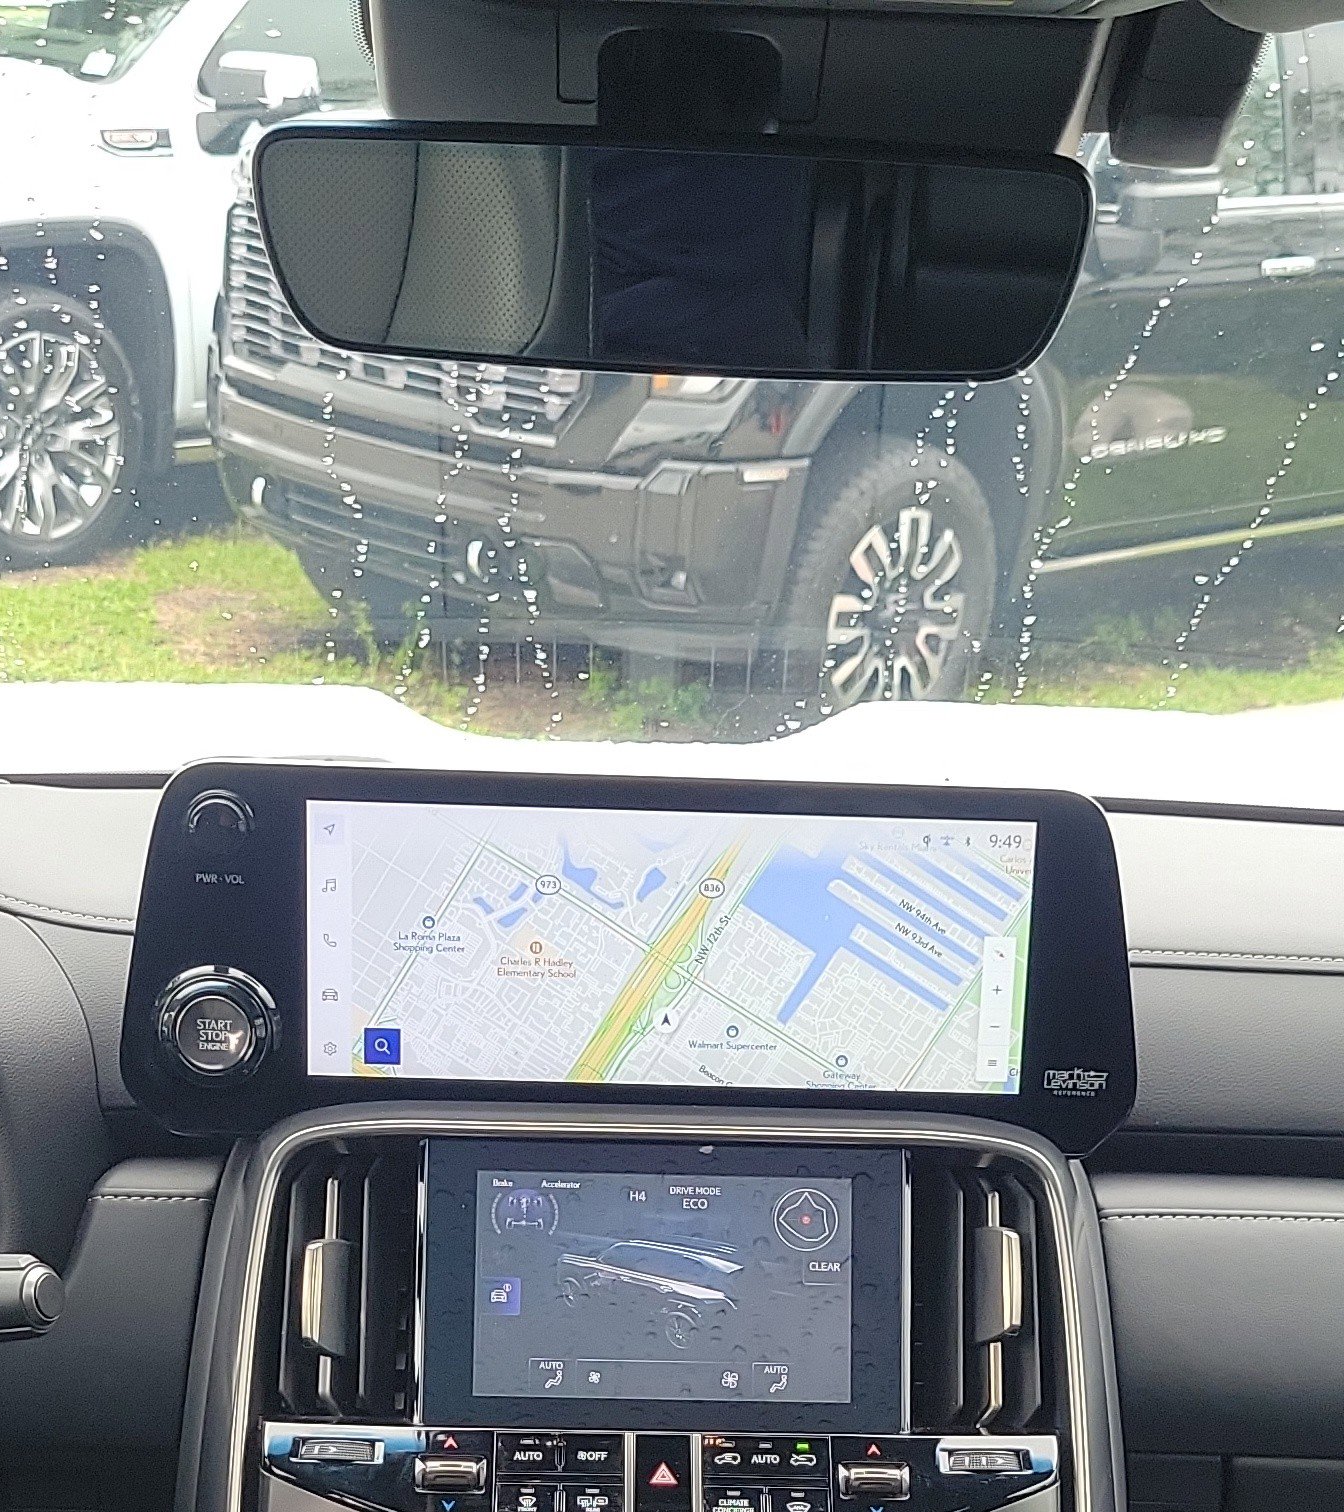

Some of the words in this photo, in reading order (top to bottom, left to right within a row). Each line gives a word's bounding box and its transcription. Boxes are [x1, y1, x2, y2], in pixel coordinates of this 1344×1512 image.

[989, 834, 1023, 849] 9:49
[196, 873, 218, 884] PWR
[224, 874, 245, 885] VOL
[540, 880, 557, 889] 973
[899, 898, 915, 912] NW
[915, 908, 932, 925] 94th
[932, 922, 946, 935] Ave
[398, 931, 408, 940] La
[438, 932, 461, 942] Plaza
[694, 943, 710, 965] NW
[706, 922, 724, 945] 12th
[719, 914, 732, 930] St
[895, 922, 911, 936] NW
[911, 932, 929, 949] 93rd
[928, 945, 943, 958] Ave
[393, 943, 433, 954] Shopping
[435, 944, 465, 953] Center
[500, 956, 532, 966] Charles
[534, 957, 541, 966] R
[543, 958, 574, 969] Hadley
[497, 967, 545, 978] Elementary
[548, 968, 577, 978] School
[196, 1018, 233, 1031] START
[199, 1030, 229, 1042] STOP
[198, 1042, 230, 1051] ENGINE
[688, 1040, 724, 1050] Walmart
[726, 1042, 778, 1051] Supercenter
[699, 1064, 729, 1086] Beacon
[822, 1070, 861, 1081] Gateway
[541, 1180, 581, 1189] Accelerator
[629, 1190, 647, 1202] H4
[669, 1186, 695, 1195] DRIVE
[696, 1187, 722, 1196] MODE
[682, 1198, 708, 1209] ECO
[809, 1261, 842, 1273] CLEAR
[539, 1361, 564, 1371] AUTO
[763, 1364, 789, 1374] AUTO
[513, 1451, 544, 1461] AUTO
[587, 1451, 609, 1461] OFF
[750, 1454, 780, 1465] AUTO
[718, 1499, 750, 1507] CLIMATE
